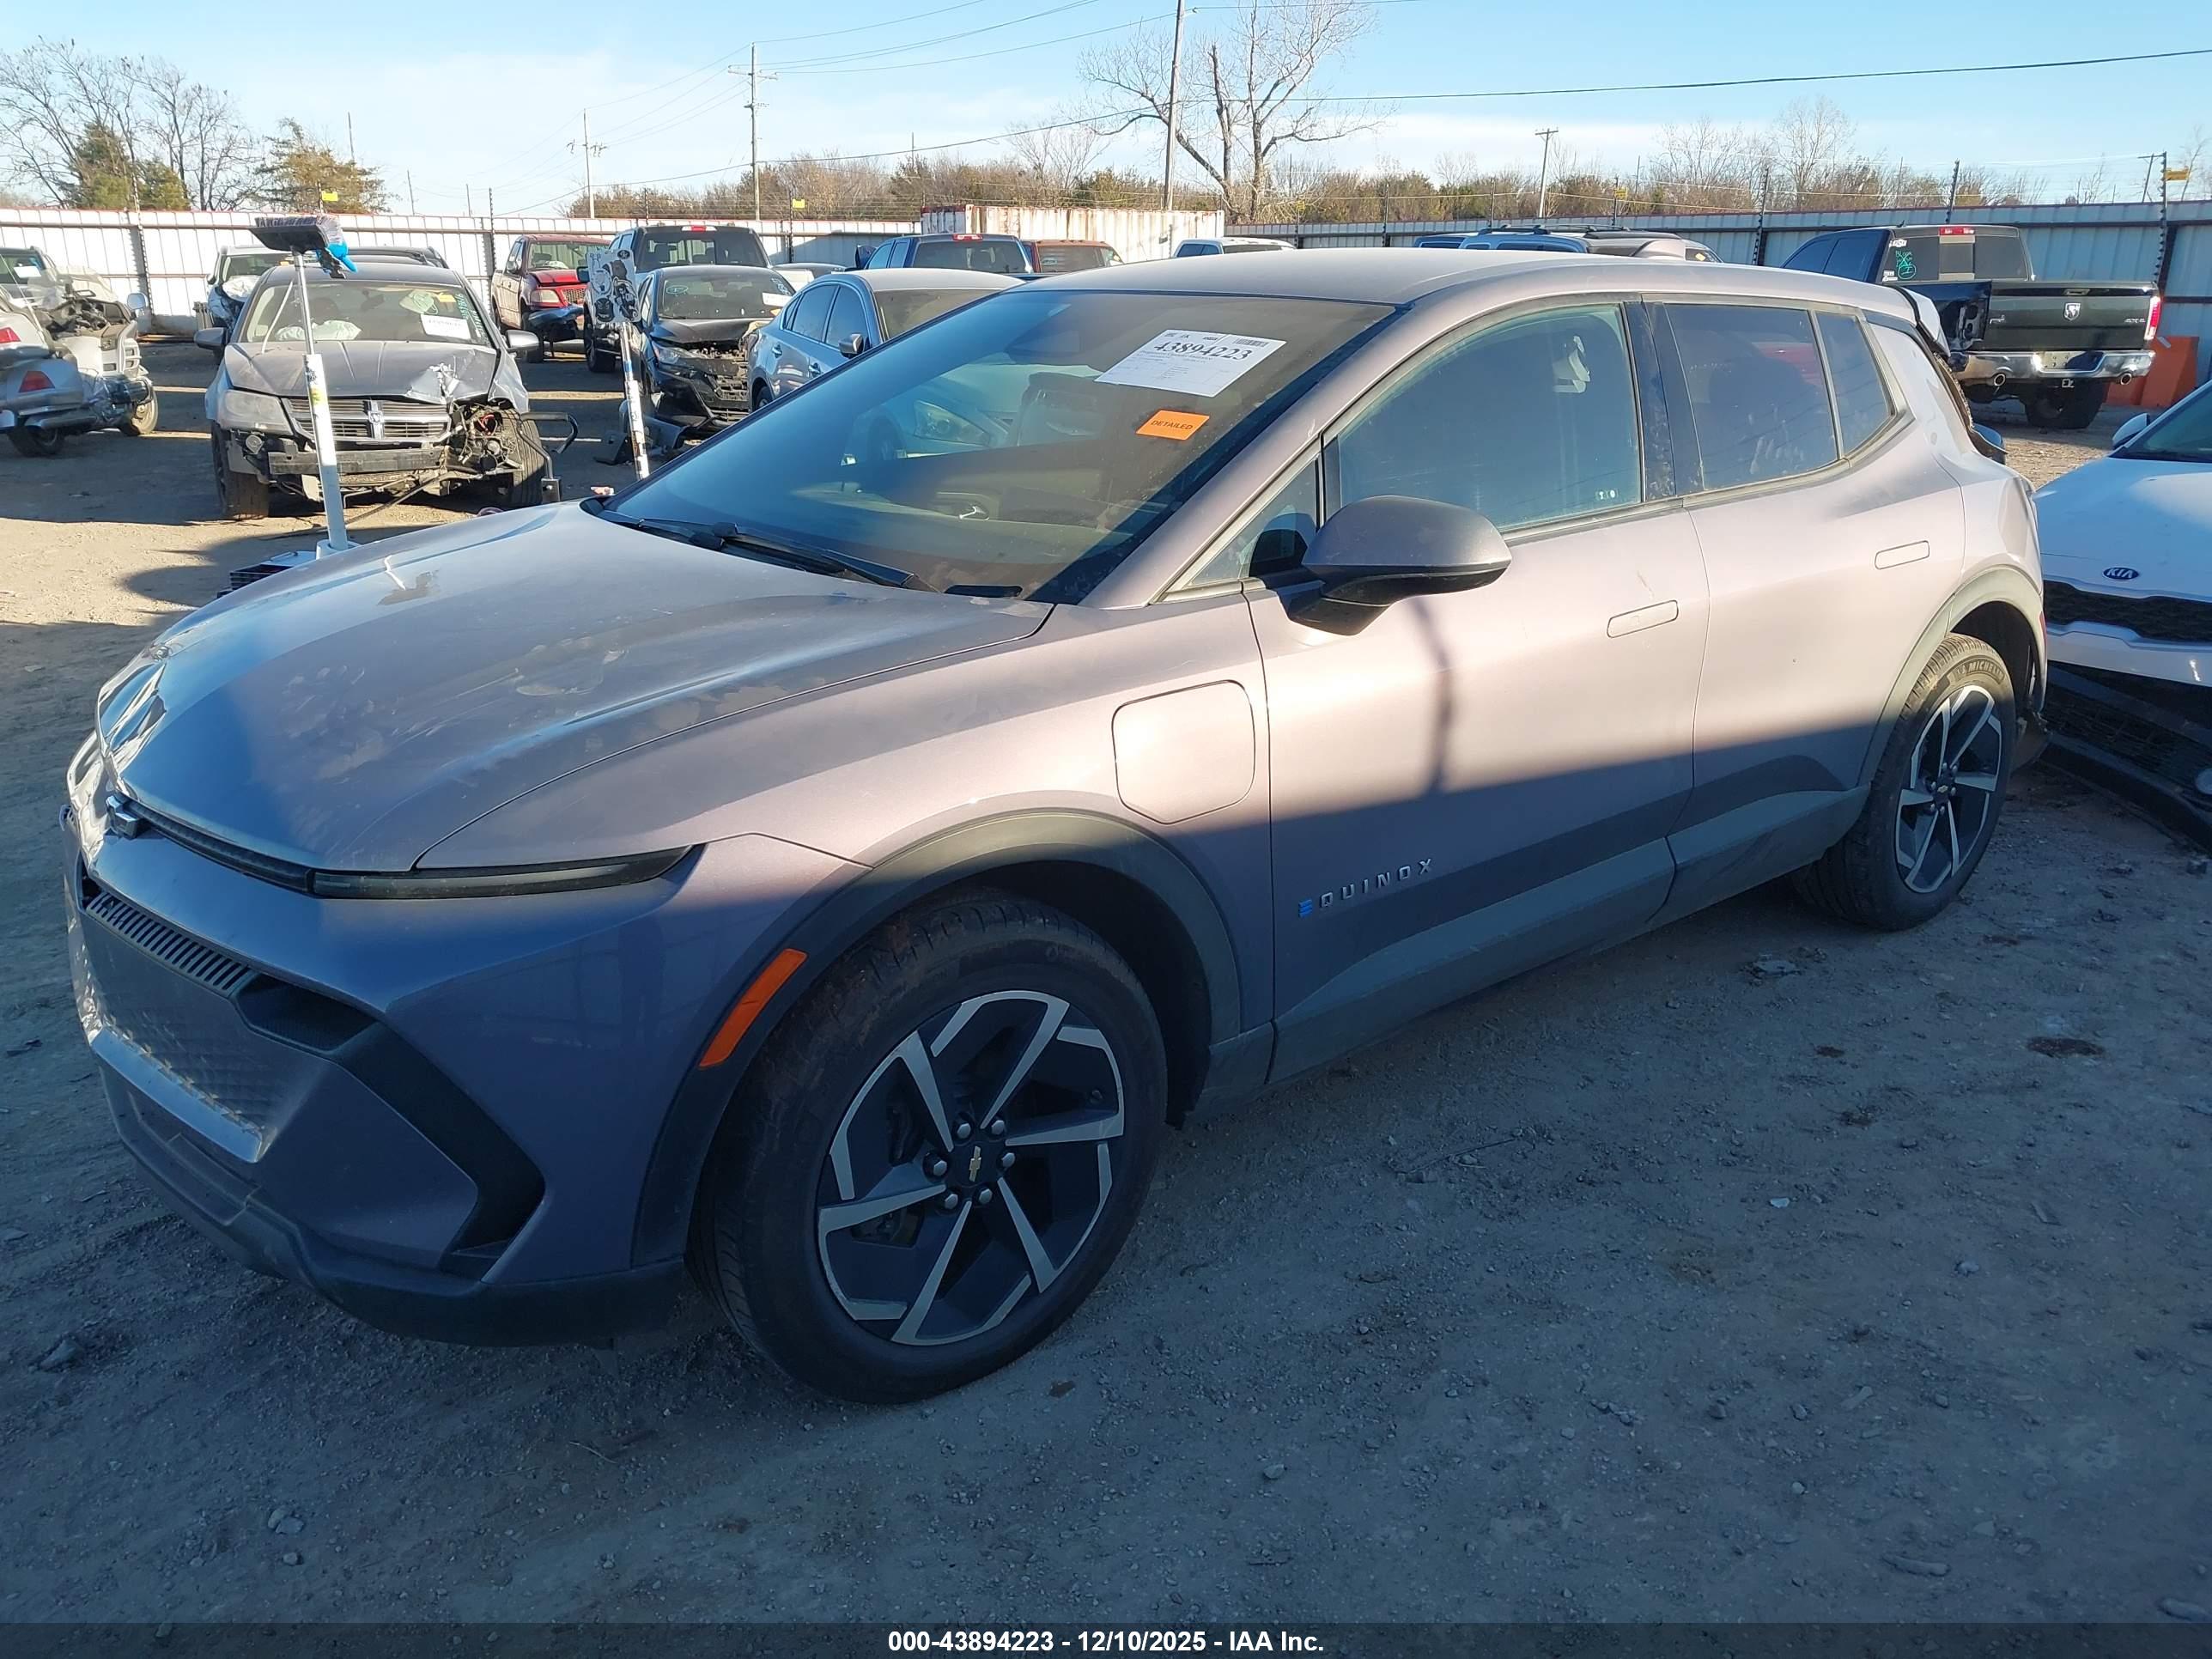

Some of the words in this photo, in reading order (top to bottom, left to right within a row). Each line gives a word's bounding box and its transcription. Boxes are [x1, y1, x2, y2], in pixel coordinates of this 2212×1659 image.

[1153, 341, 1253, 361] 43894223
[1150, 419, 1194, 431] DETAILED
[2106, 568, 2134, 579] KIA
[1967, 659, 2004, 682] MICHELIN
[1297, 858, 1432, 919] EQUINOX
